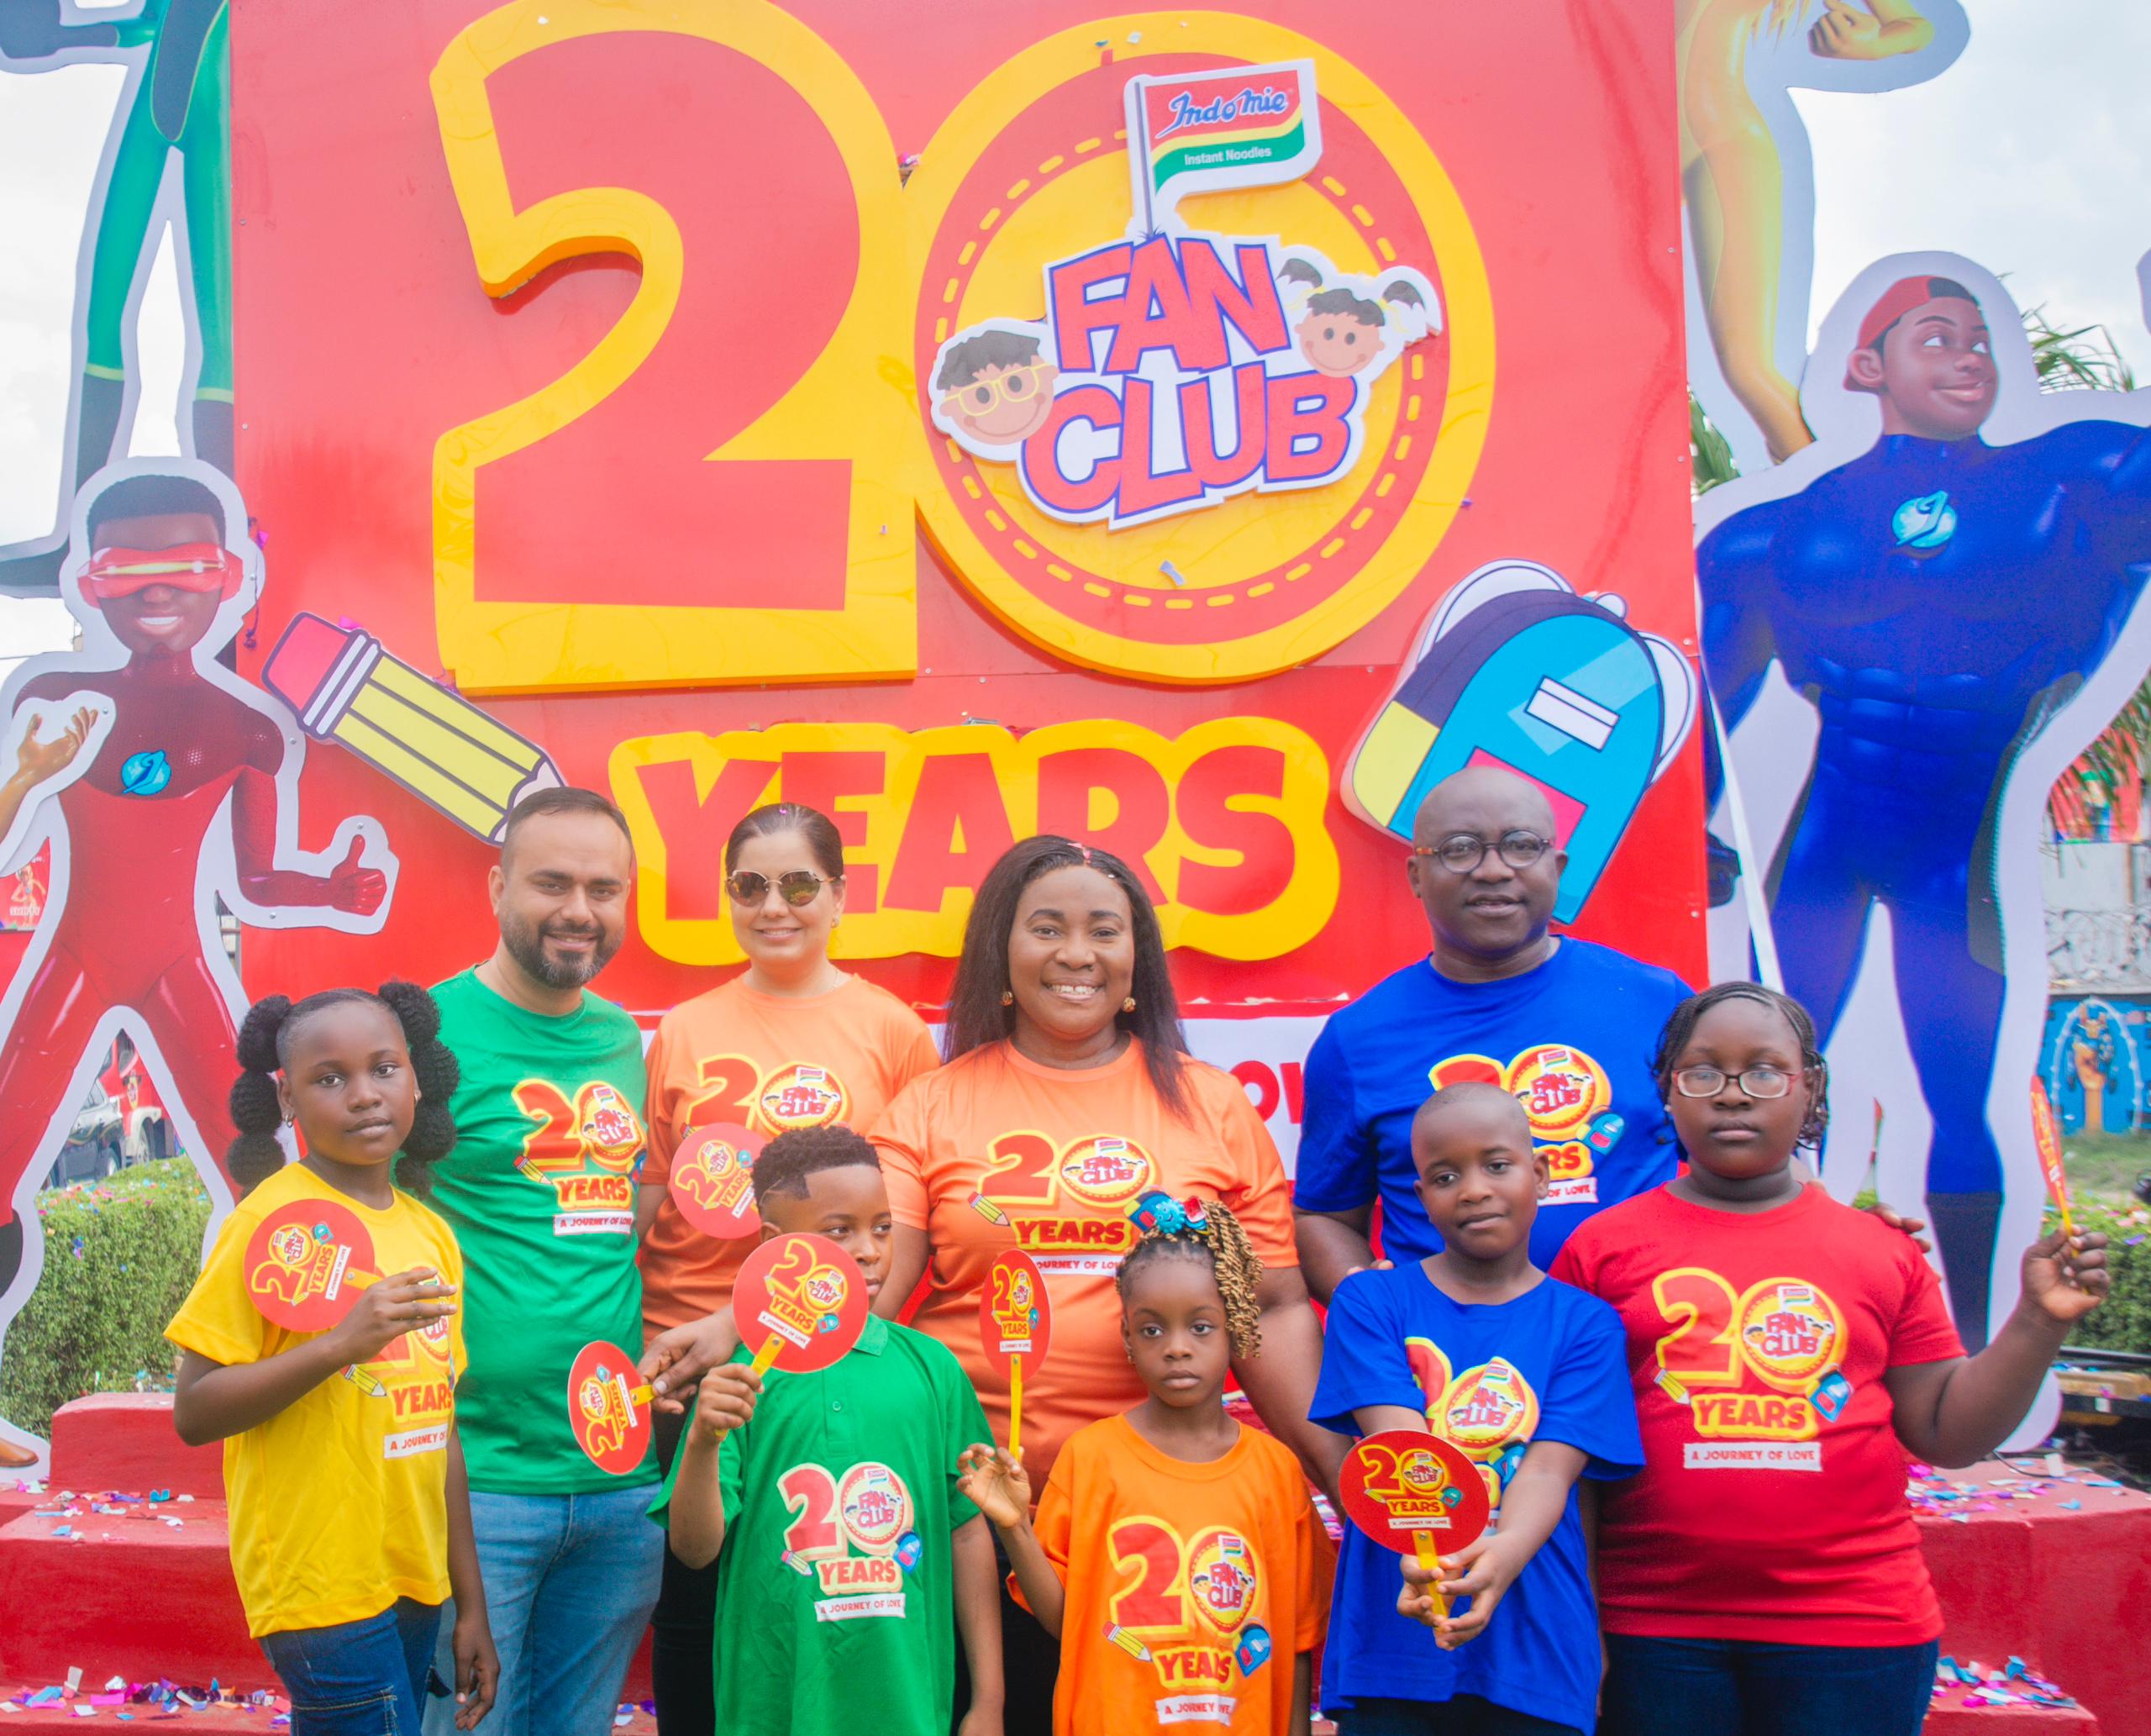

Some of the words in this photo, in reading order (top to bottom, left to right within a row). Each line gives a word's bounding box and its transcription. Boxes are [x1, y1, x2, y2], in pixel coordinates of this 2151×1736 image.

[1155, 87, 1289, 139] Indomie
[1185, 150, 1224, 166] Instant
[1226, 146, 1273, 161] Noodles
[1049, 232, 1292, 376] FAN
[429, 0, 1495, 695] 20
[1021, 360, 1357, 519] CLUB
[634, 744, 1296, 922] YEARS
[782, 1086, 818, 1102] FAN
[1531, 1073, 1571, 1094] FAN
[775, 1100, 827, 1118] CLUB
[1531, 1087, 1582, 1115] CLUB
[511, 1079, 648, 1170] 20
[978, 1129, 1158, 1208] 20
[1083, 1155, 1123, 1170] FAN
[1077, 1168, 1134, 1185] CLUB
[556, 1177, 628, 1202] YEARS
[1565, 1184, 1591, 1196] LOVE
[560, 1218, 567, 1228] A
[571, 1218, 607, 1227] JOURNEY
[1015, 1219, 1125, 1245] YEARS
[309, 1245, 334, 1291] YEARS
[768, 1239, 849, 1314] 20
[1037, 1260, 1081, 1270] OURNEY
[1084, 1261, 1098, 1270] OF
[772, 1297, 814, 1331] YEARS
[1766, 1311, 1808, 1333] FAN
[1002, 1321, 1028, 1335] YEARS
[1652, 1267, 1845, 1390] 20
[1760, 1334, 1820, 1358] CLUB
[391, 1382, 452, 1417] YEARS
[1696, 1397, 1807, 1429] YEARS
[389, 1440, 398, 1451] A
[402, 1434, 439, 1449] JOURNEY
[1691, 1450, 1700, 1460] A
[1703, 1450, 1764, 1460] JOURNEY
[1769, 1451, 1783, 1460] OF
[1788, 1450, 1816, 1460] LOVE
[1358, 1444, 1451, 1496] 20
[1411, 1473, 1438, 1485] CLUB
[777, 1462, 913, 1558] 20
[858, 1491, 887, 1510] FAN
[1388, 1501, 1441, 1513] YEARS
[856, 1508, 896, 1528] CLUB
[818, 1560, 897, 1586] YEARS
[1107, 1515, 1261, 1637] 20
[1208, 1563, 1239, 1586] FAN
[820, 1604, 827, 1614] A
[829, 1599, 871, 1613] JOURNEY
[874, 1599, 885, 1608] OF
[887, 1599, 902, 1607] LOVE
[1207, 1584, 1244, 1608] CLUB
[1165, 1705, 1173, 1714] A
